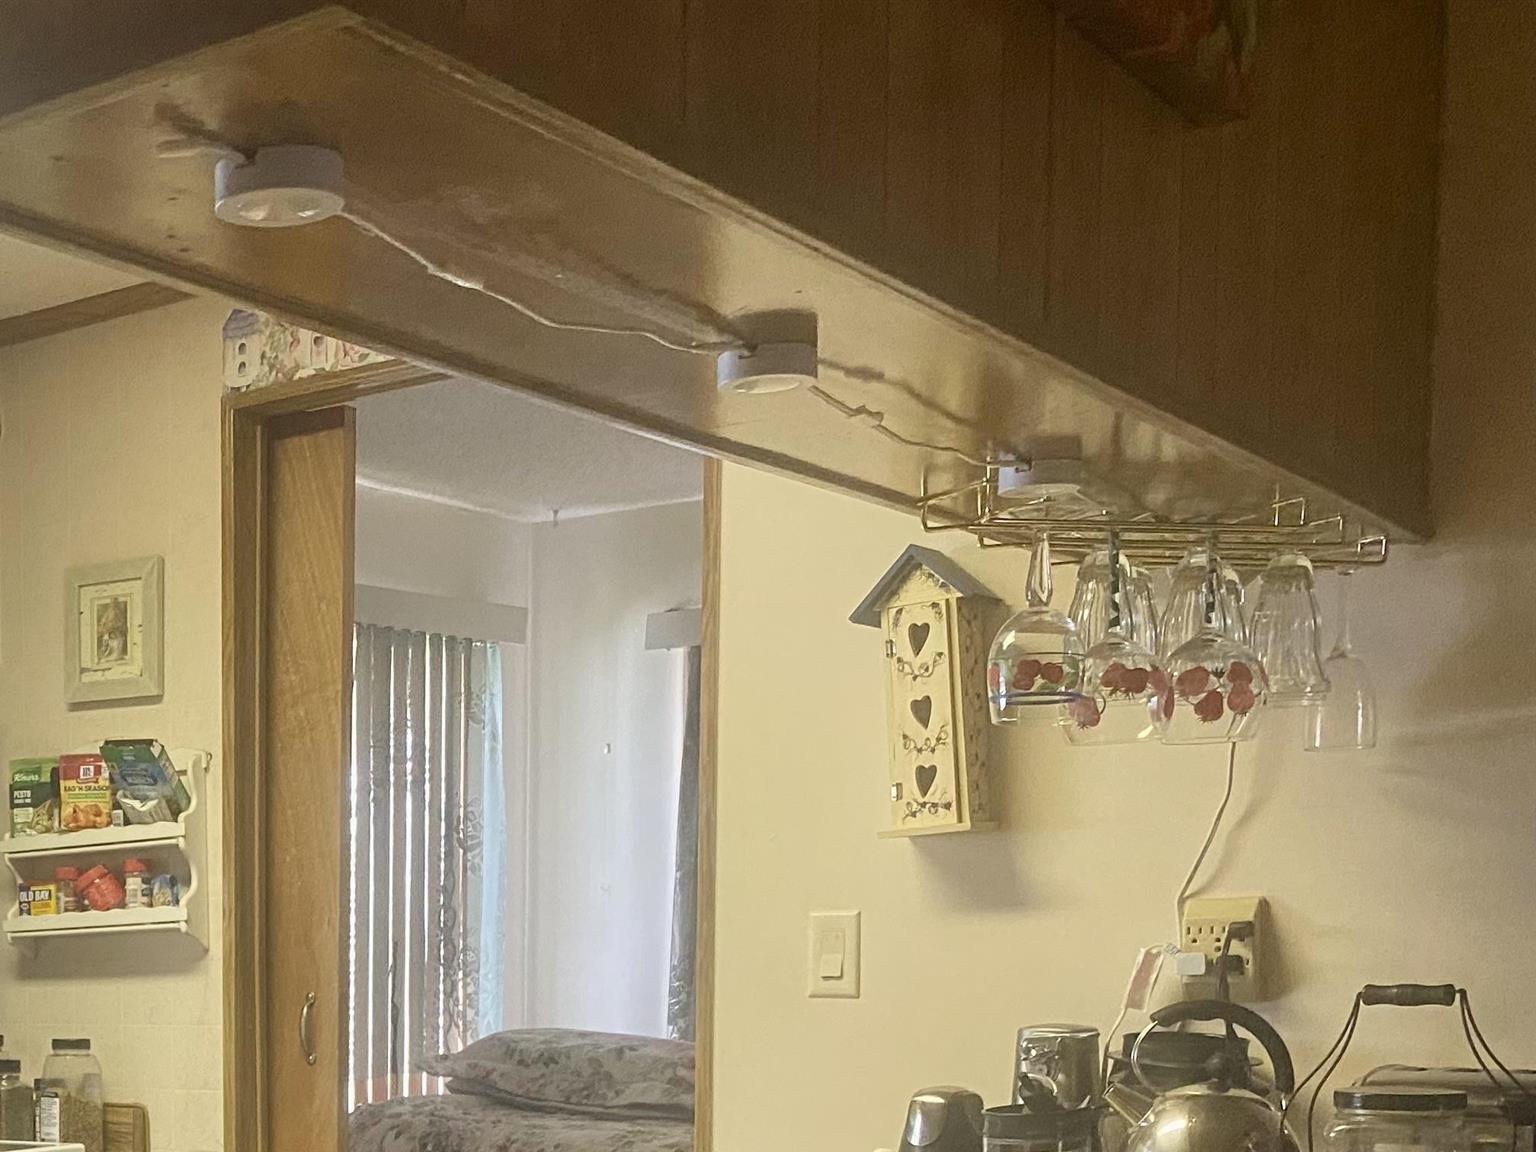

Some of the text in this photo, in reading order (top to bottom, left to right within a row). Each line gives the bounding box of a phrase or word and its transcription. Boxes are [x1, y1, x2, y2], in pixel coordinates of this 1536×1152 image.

[13, 790, 32, 799] PESTO
[19, 889, 50, 902] OLD BAY
